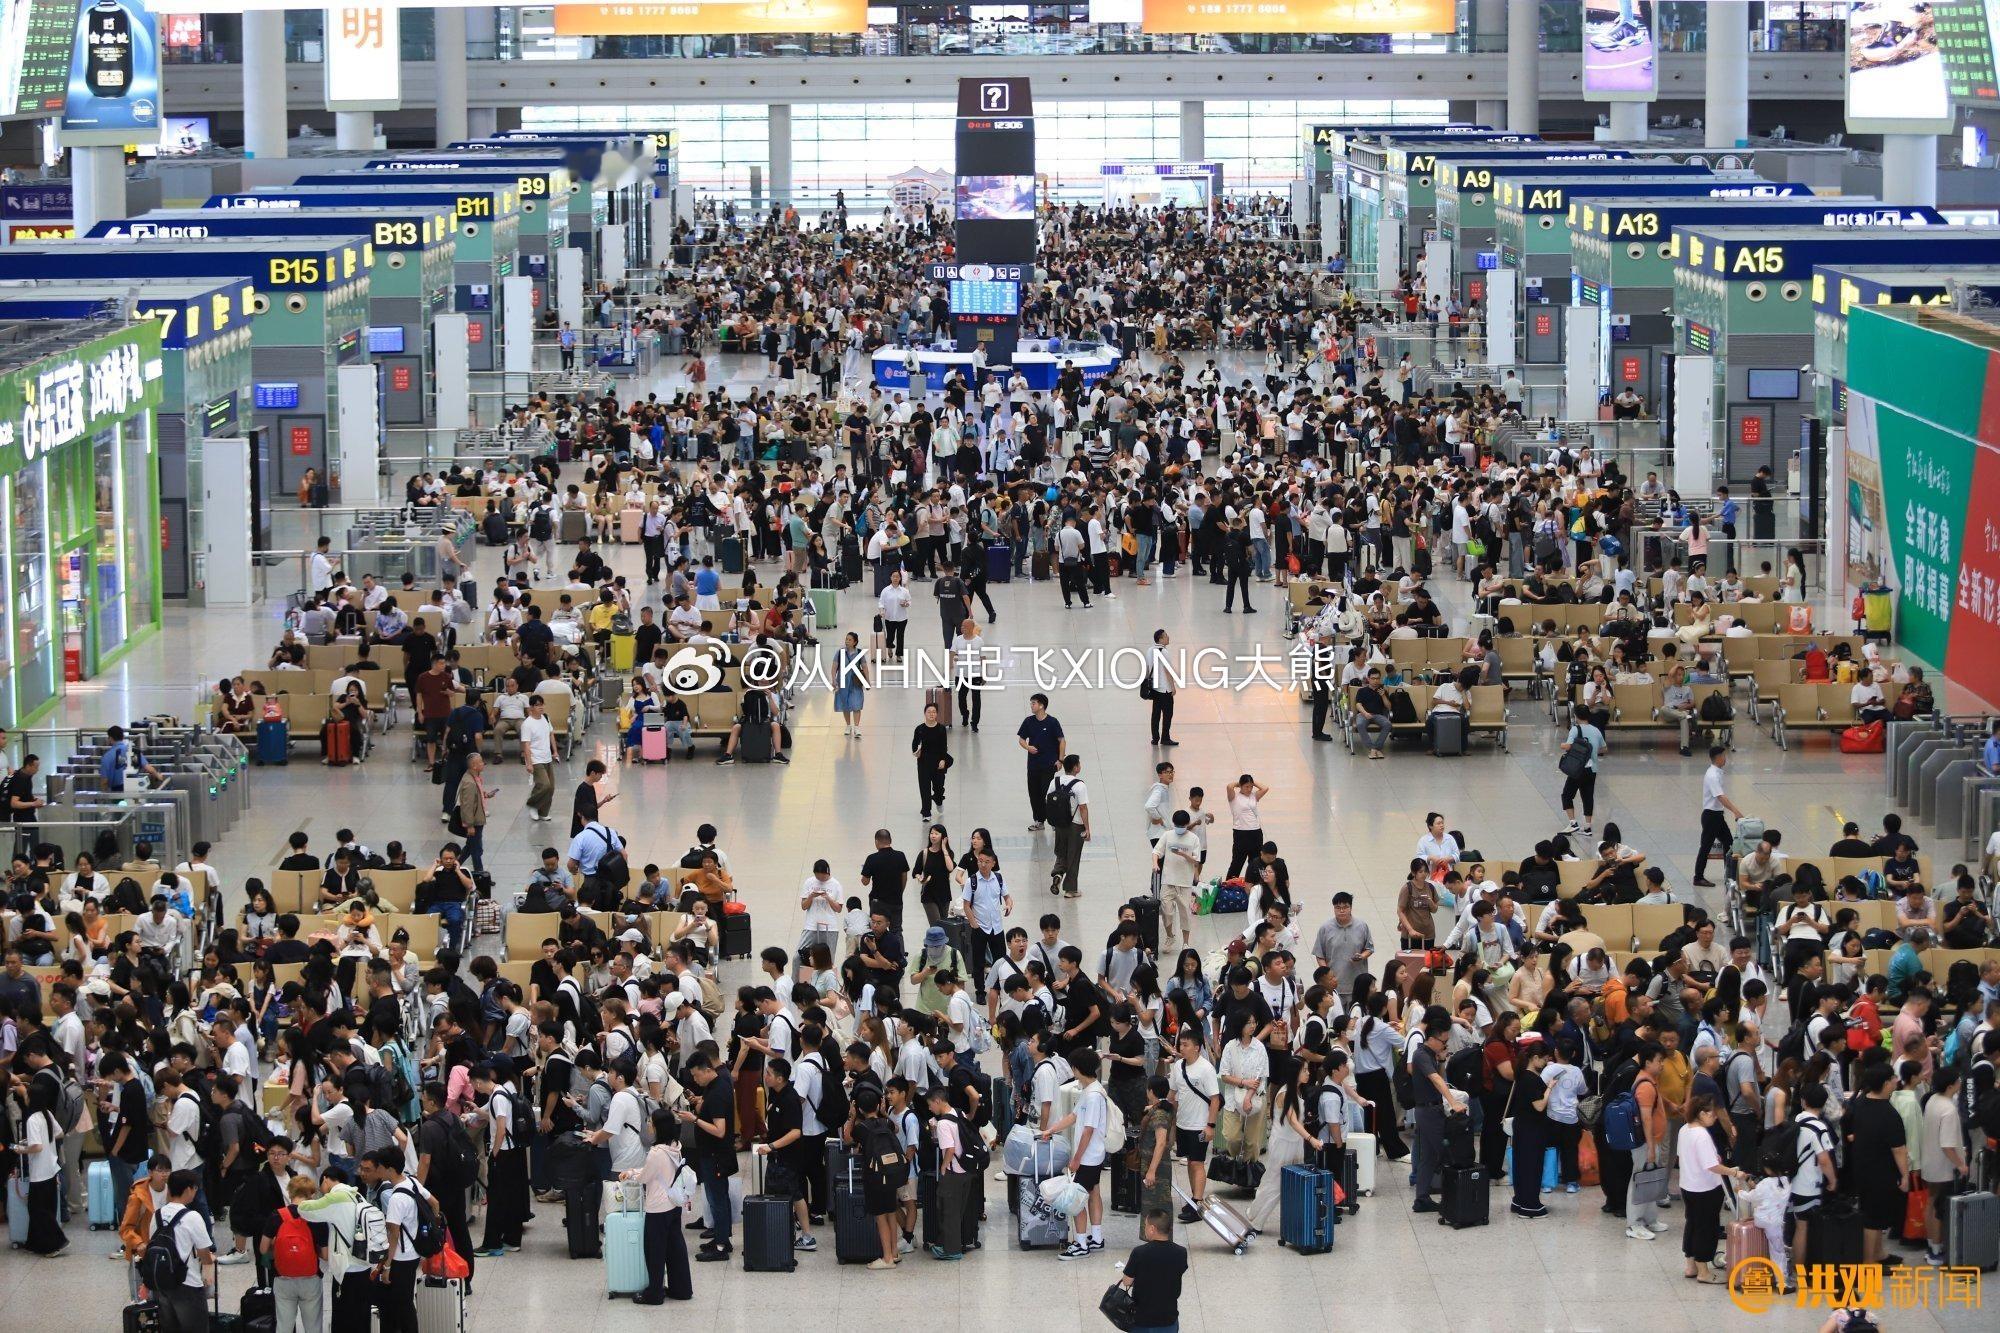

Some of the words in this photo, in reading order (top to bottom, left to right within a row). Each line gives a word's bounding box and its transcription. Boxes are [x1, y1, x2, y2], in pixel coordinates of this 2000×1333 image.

[342, 7, 383, 49] 明
[1411, 156, 1435, 172] A7
[518, 177, 545, 195] B9
[1463, 170, 1491, 188] A9
[457, 197, 489, 217] B11
[1529, 189, 1562, 209] A11
[374, 223, 418, 246] B13
[1615, 213, 1659, 236] A13
[270, 258, 319, 284] B15
[1732, 247, 1784, 273] A15
[1905, 499, 1950, 565] 全新形象
[1904, 554, 1949, 622] 即将揭幕
